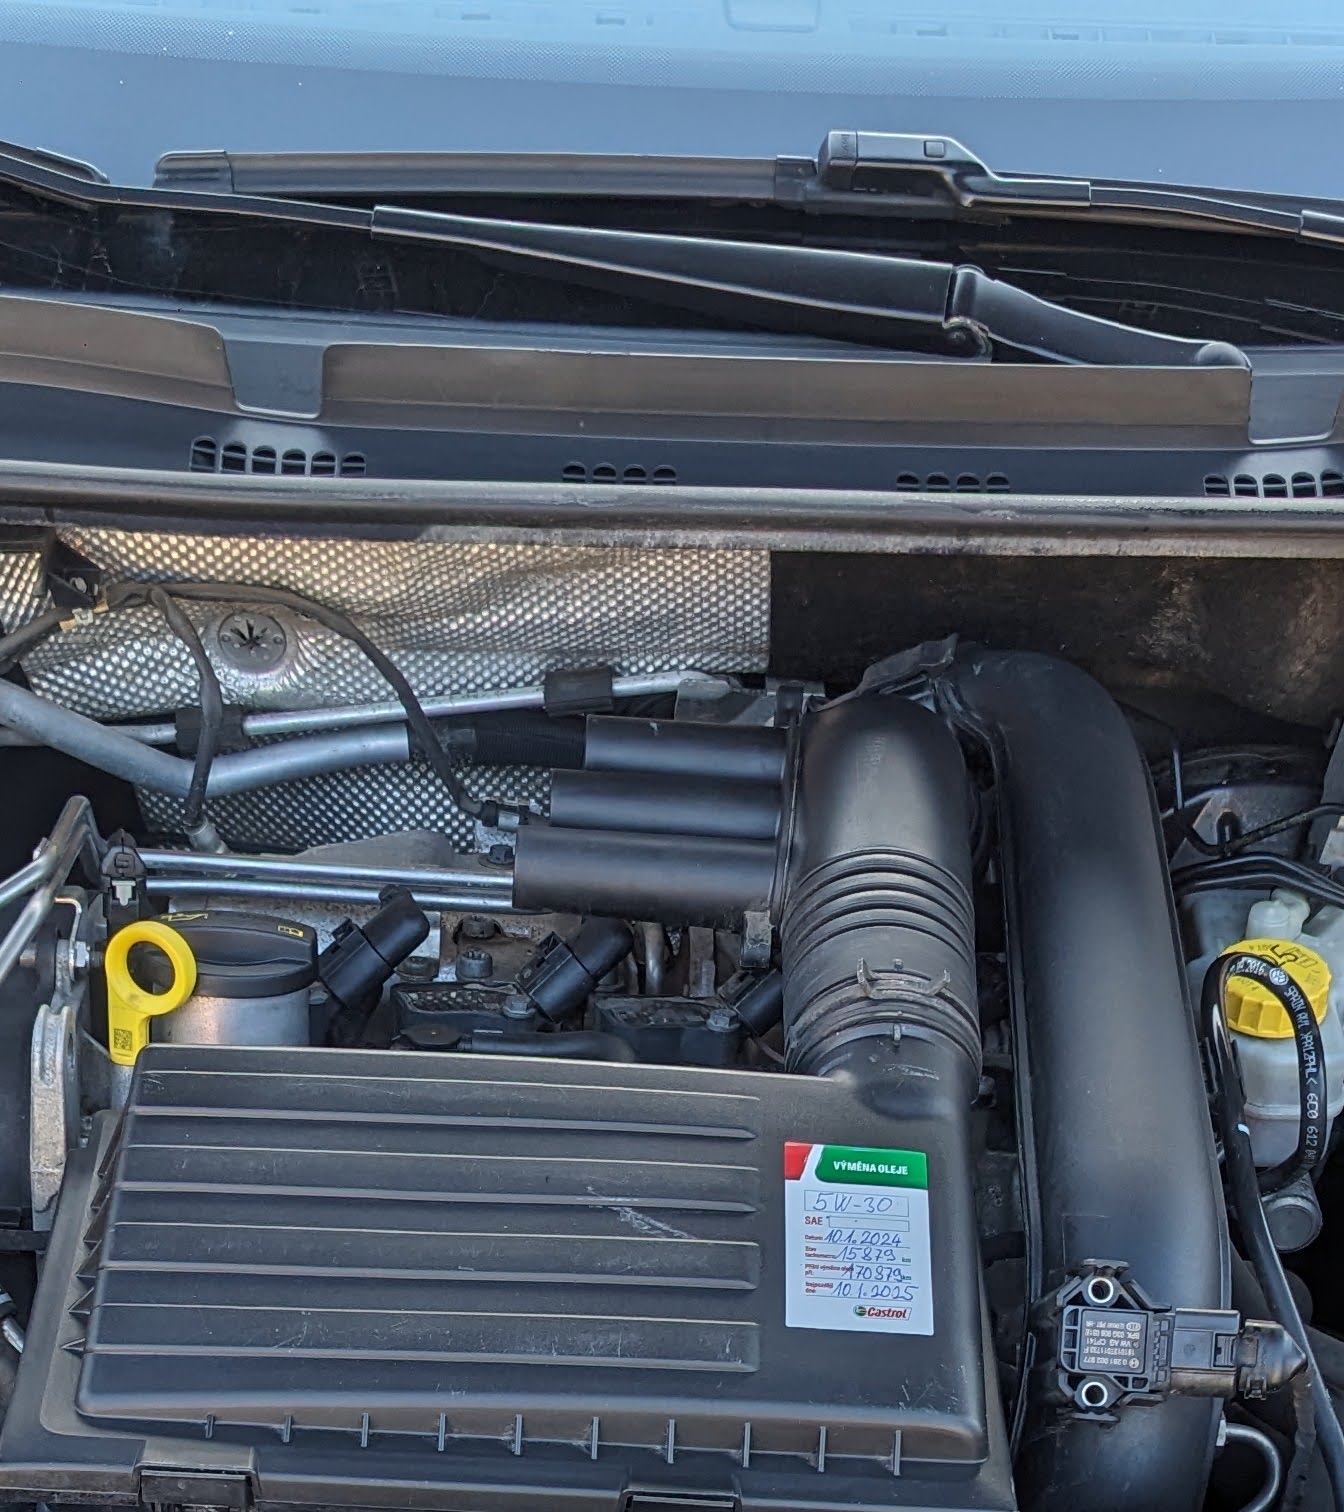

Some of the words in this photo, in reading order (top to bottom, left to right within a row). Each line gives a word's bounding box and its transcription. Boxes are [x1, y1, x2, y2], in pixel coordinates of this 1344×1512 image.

[833, 1160, 876, 1173] VÝMĚNA
[878, 1164, 908, 1175] OLEJE
[805, 1216, 823, 1225] SAE
[867, 1307, 907, 1319] Castrol
